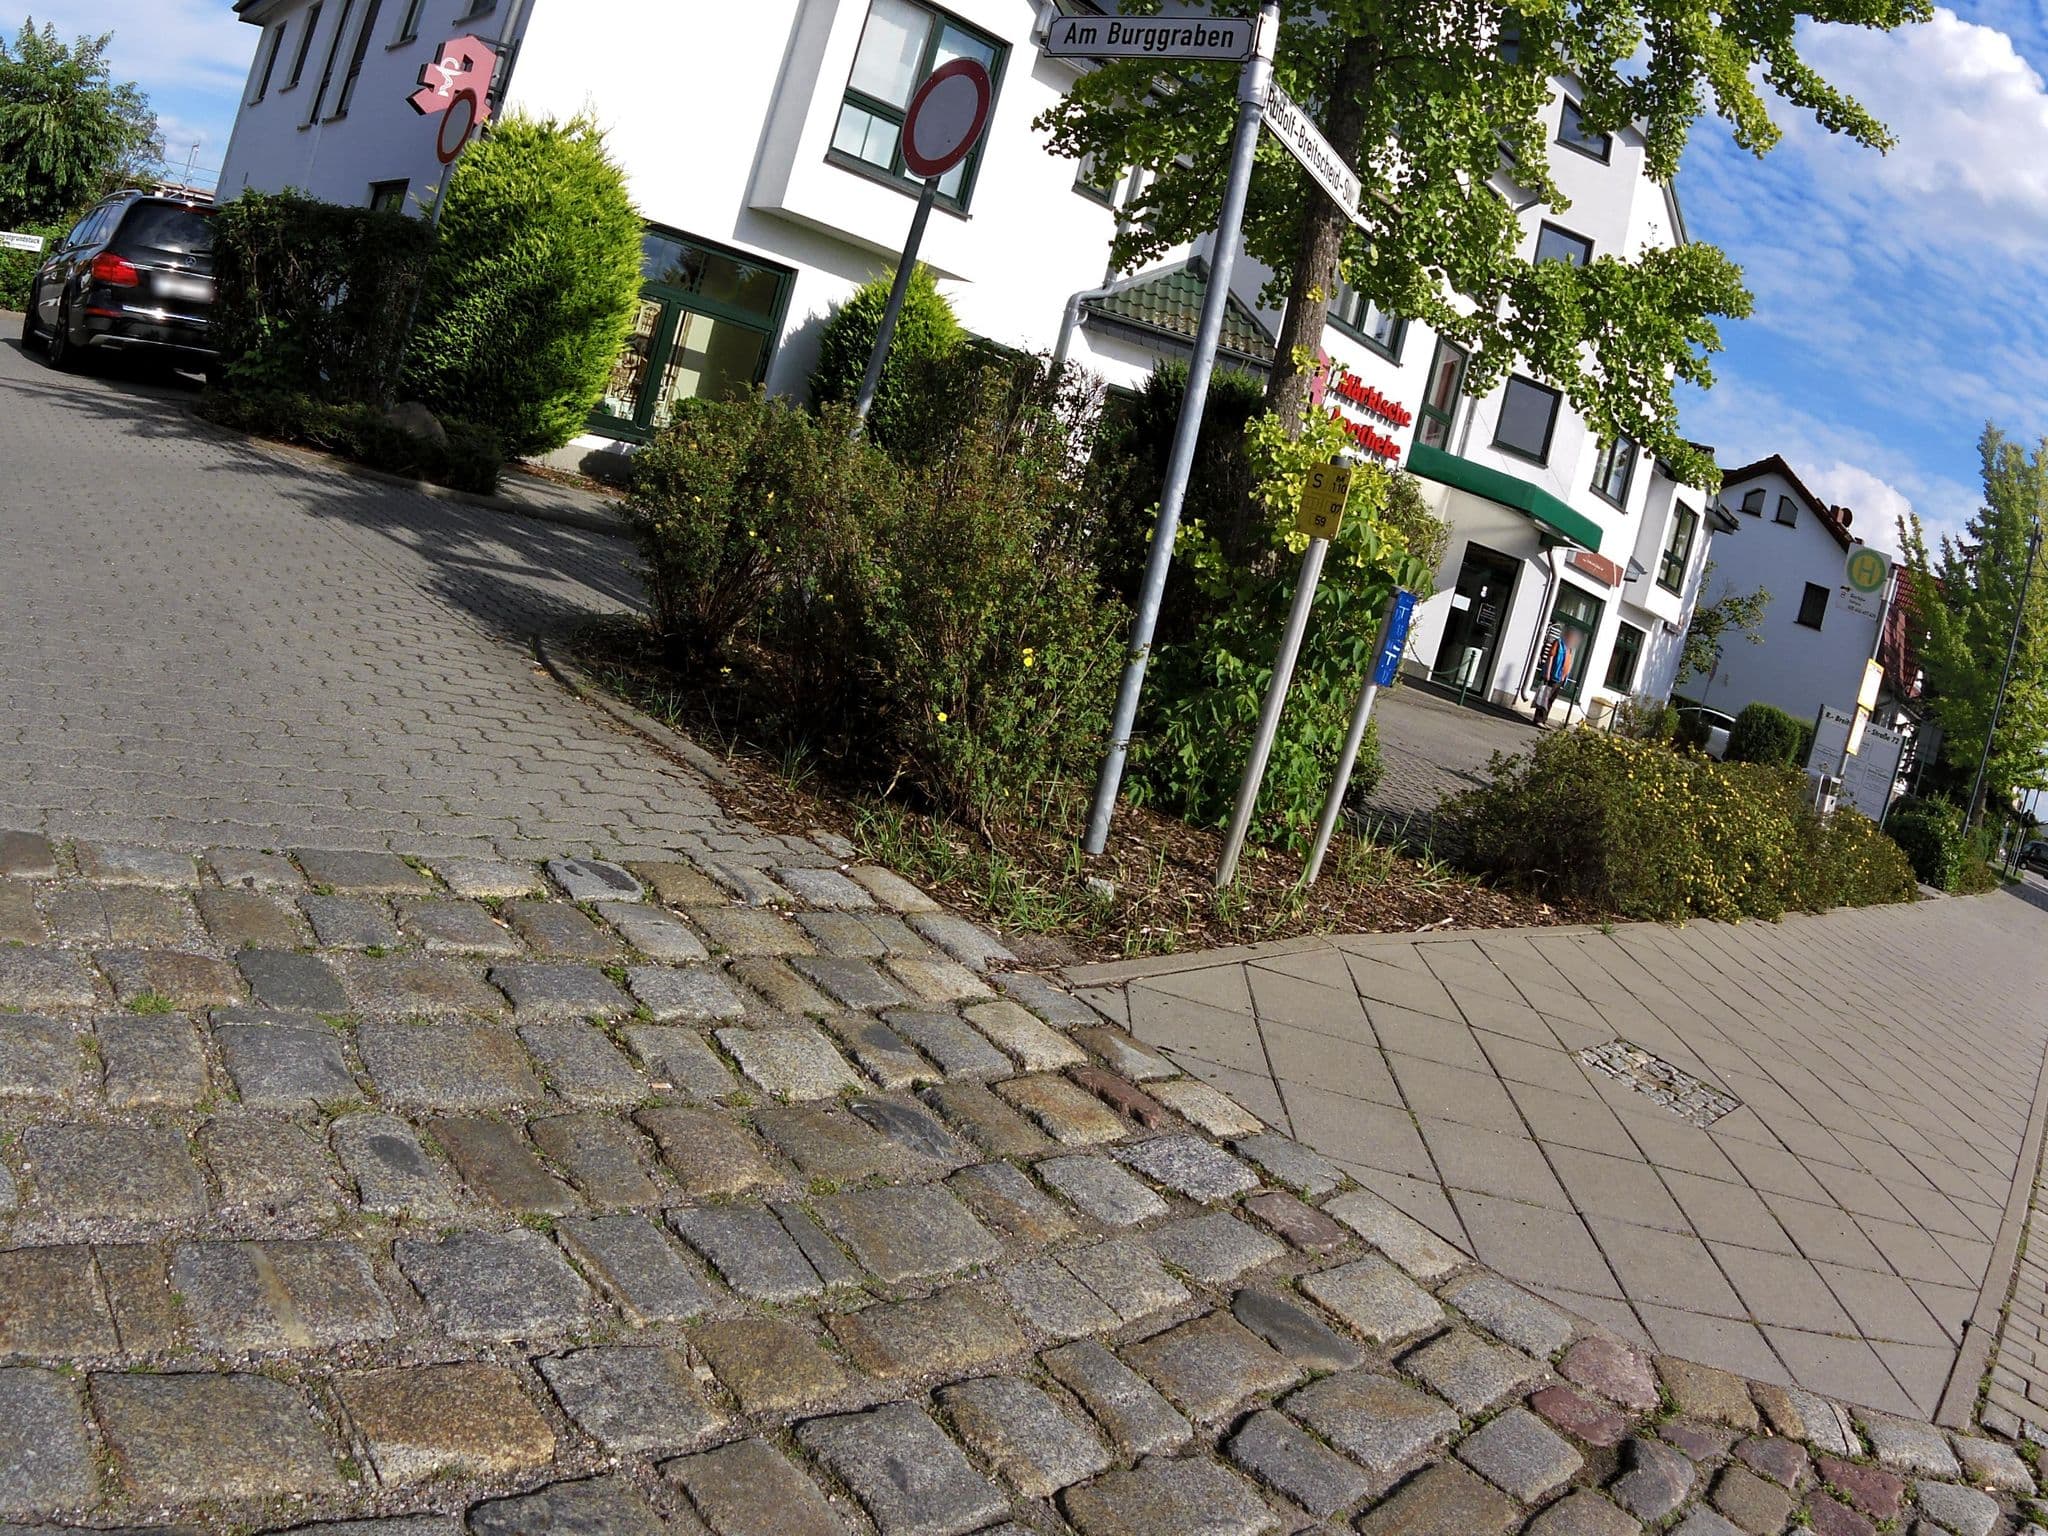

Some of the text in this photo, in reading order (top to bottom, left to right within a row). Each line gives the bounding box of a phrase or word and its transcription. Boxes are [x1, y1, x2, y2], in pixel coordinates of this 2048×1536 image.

[1064, 22, 1234, 52] Am Burggraben
[1313, 473, 1324, 488] S
[1859, 556, 1876, 584] H
